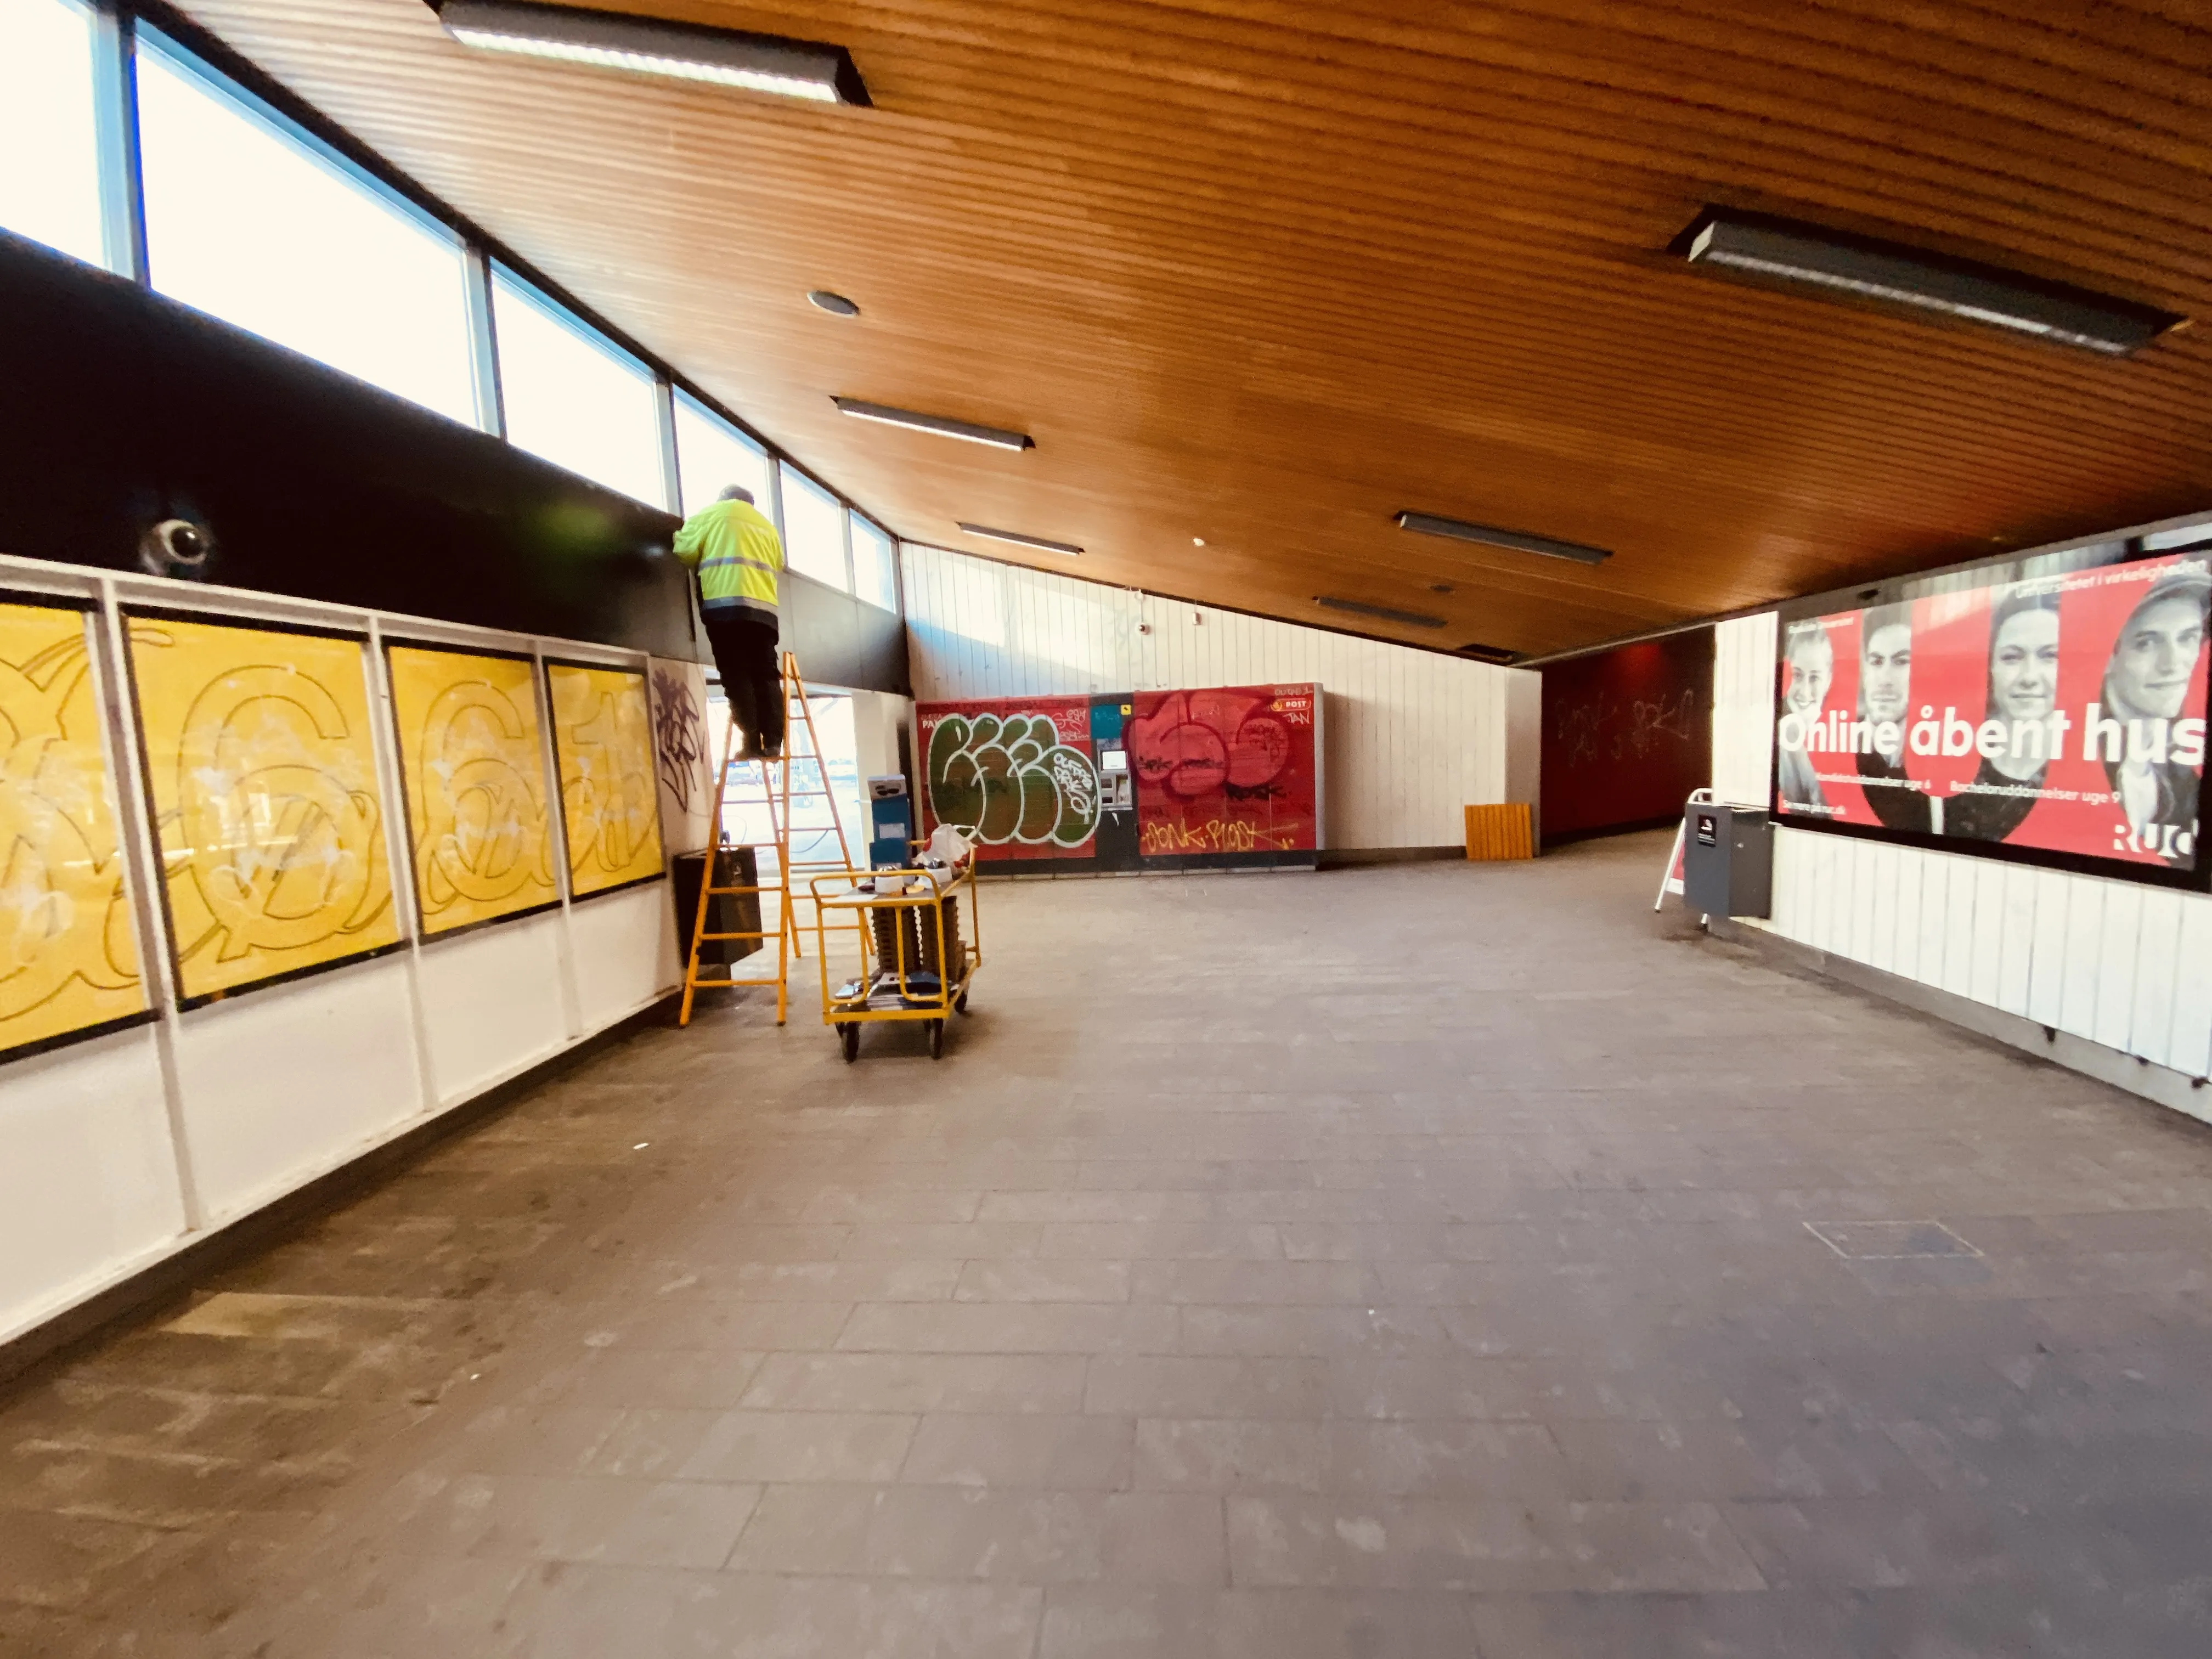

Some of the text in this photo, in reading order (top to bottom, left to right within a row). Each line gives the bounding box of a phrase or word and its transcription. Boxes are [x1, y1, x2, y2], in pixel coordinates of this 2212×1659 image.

[1779, 702, 2206, 766] Online åbent hus
[2082, 792, 2108, 805] uge
[2112, 791, 2120, 804] 9
